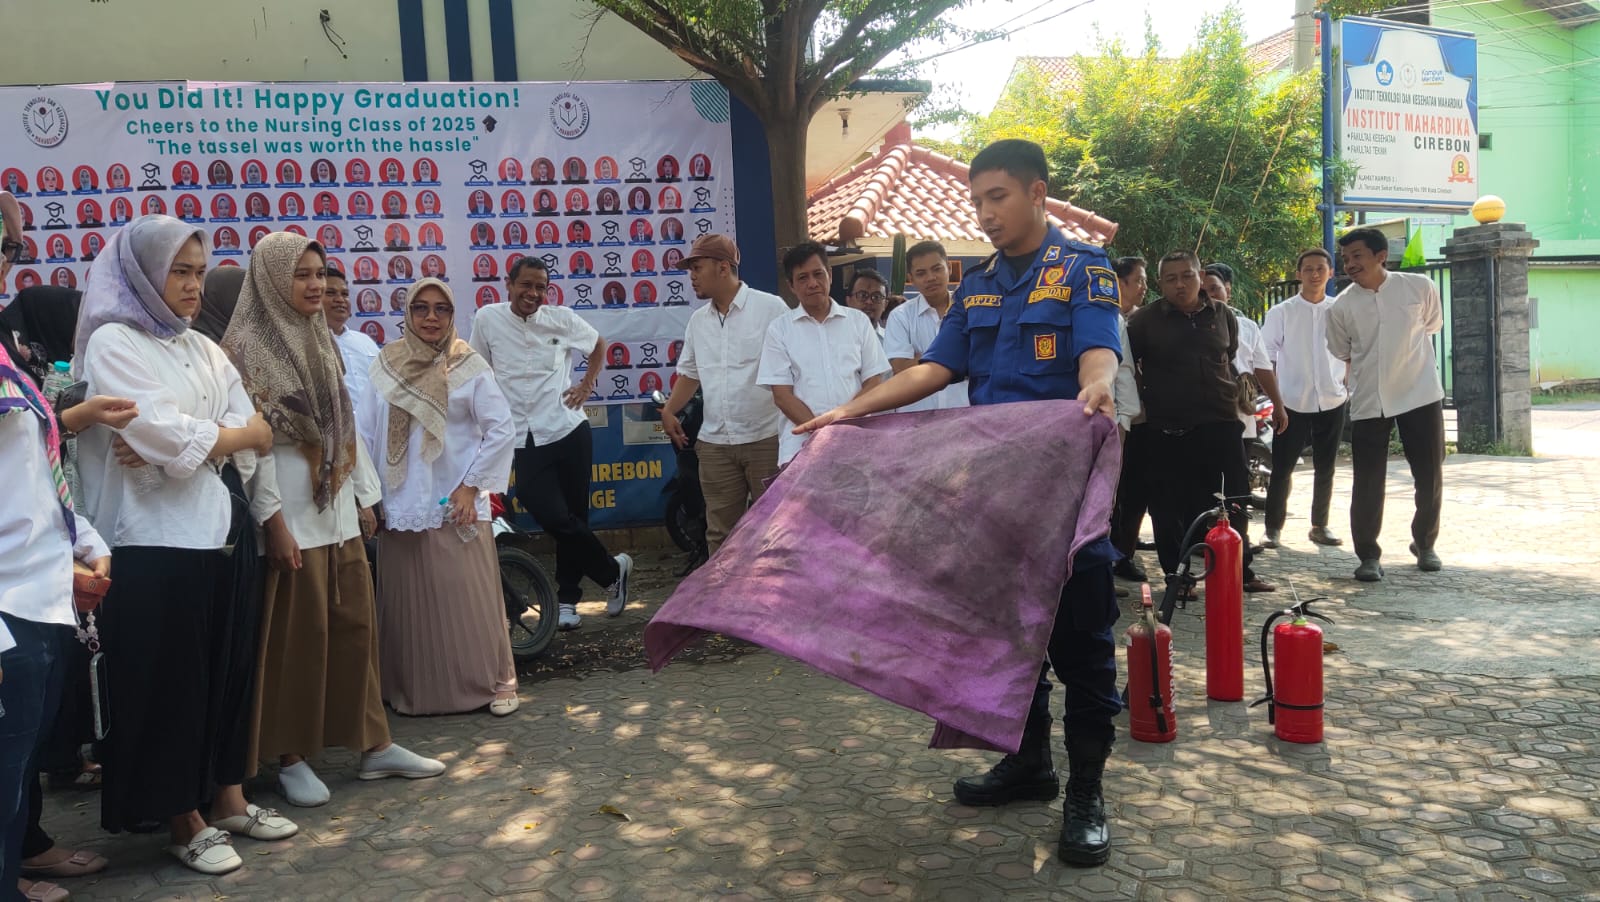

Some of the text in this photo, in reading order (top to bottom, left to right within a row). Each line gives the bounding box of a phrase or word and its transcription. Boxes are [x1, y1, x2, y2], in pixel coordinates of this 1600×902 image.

[95, 85, 520, 116] You Did It! Happy Graduation!
[1354, 87, 1376, 101] INSTITUT
[126, 115, 476, 138] Cheers to the Nursing Class of 2025
[1347, 107, 1470, 137] INSTITUT MAHARDIKA
[147, 135, 479, 155] "The tassel was worth the hassle"
[1414, 136, 1471, 153] CIREBON
[1457, 160, 1465, 174] B
[591, 460, 662, 482] IREBON
